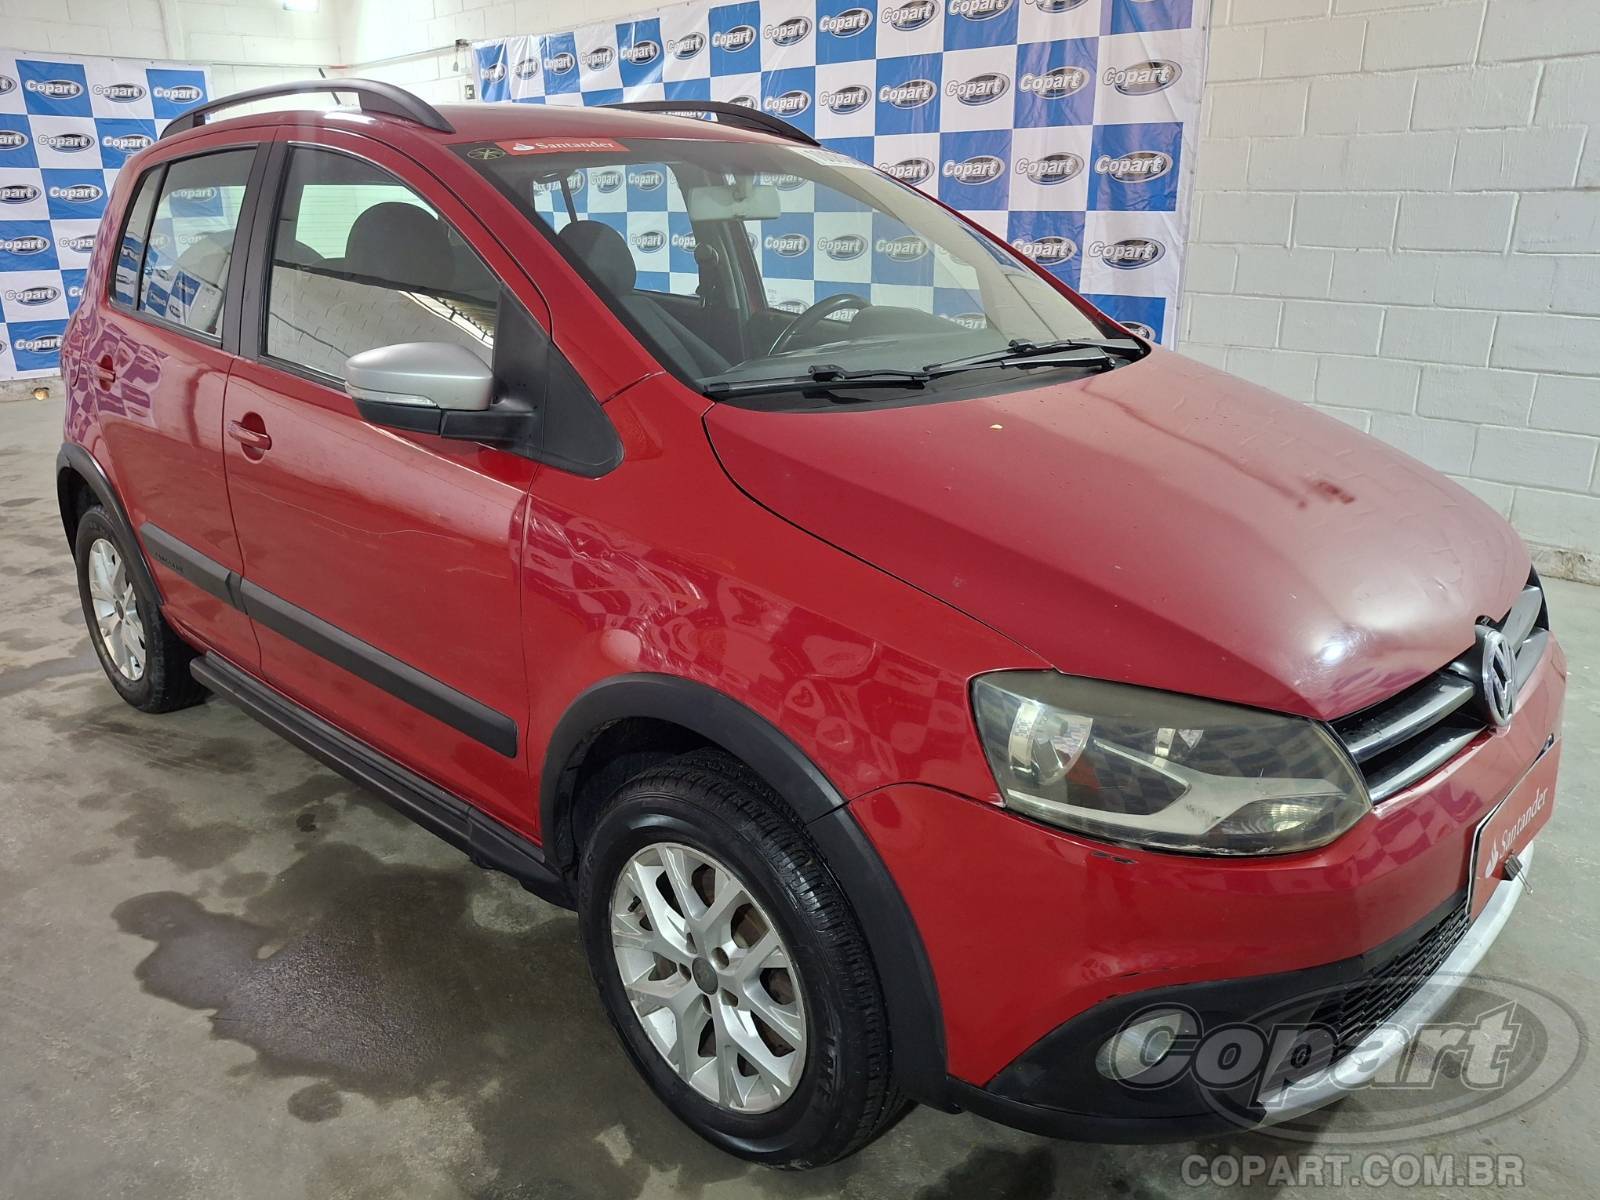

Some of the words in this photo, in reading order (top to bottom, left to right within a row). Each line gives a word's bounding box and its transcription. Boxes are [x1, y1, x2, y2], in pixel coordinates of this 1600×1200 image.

[819, 12, 867, 33] Copart
[881, 4, 931, 25] Copart
[712, 29, 751, 47] Copart
[763, 19, 806, 41] Copart
[620, 42, 655, 62] Copart
[667, 36, 700, 53] Copart
[543, 54, 570, 71] Copart
[580, 48, 611, 66] Copart
[1020, 70, 1082, 94] Copart
[1102, 63, 1171, 88] Copart
[25, 79, 78, 95] Copart
[93, 84, 140, 98] Copart
[153, 86, 198, 101] Copart
[880, 82, 930, 104] Copart
[945, 76, 1002, 99] Copart
[763, 92, 806, 112] Copart
[820, 87, 865, 109] Copart
[38, 134, 87, 149] Copart
[102, 136, 148, 150] Copart
[535, 140, 615, 149] Santander
[942, 159, 999, 180] Copart
[1015, 156, 1074, 177] Copart
[1094, 154, 1163, 177] Copart
[591, 172, 619, 190] Copart
[628, 171, 660, 188] Copart
[0, 187, 35, 201] part
[50, 186, 97, 201] Copart
[60, 238, 96, 251] Copa
[629, 232, 662, 250] Copart
[671, 233, 695, 249] Copa
[764, 235, 804, 252] Copart
[816, 236, 862, 256] Copart
[875, 239, 923, 257] Copart
[1088, 240, 1154, 263] Copart
[5, 288, 55, 303] Copart
[15, 339, 62, 351] Copart
[1501, 784, 1549, 851] Santander
